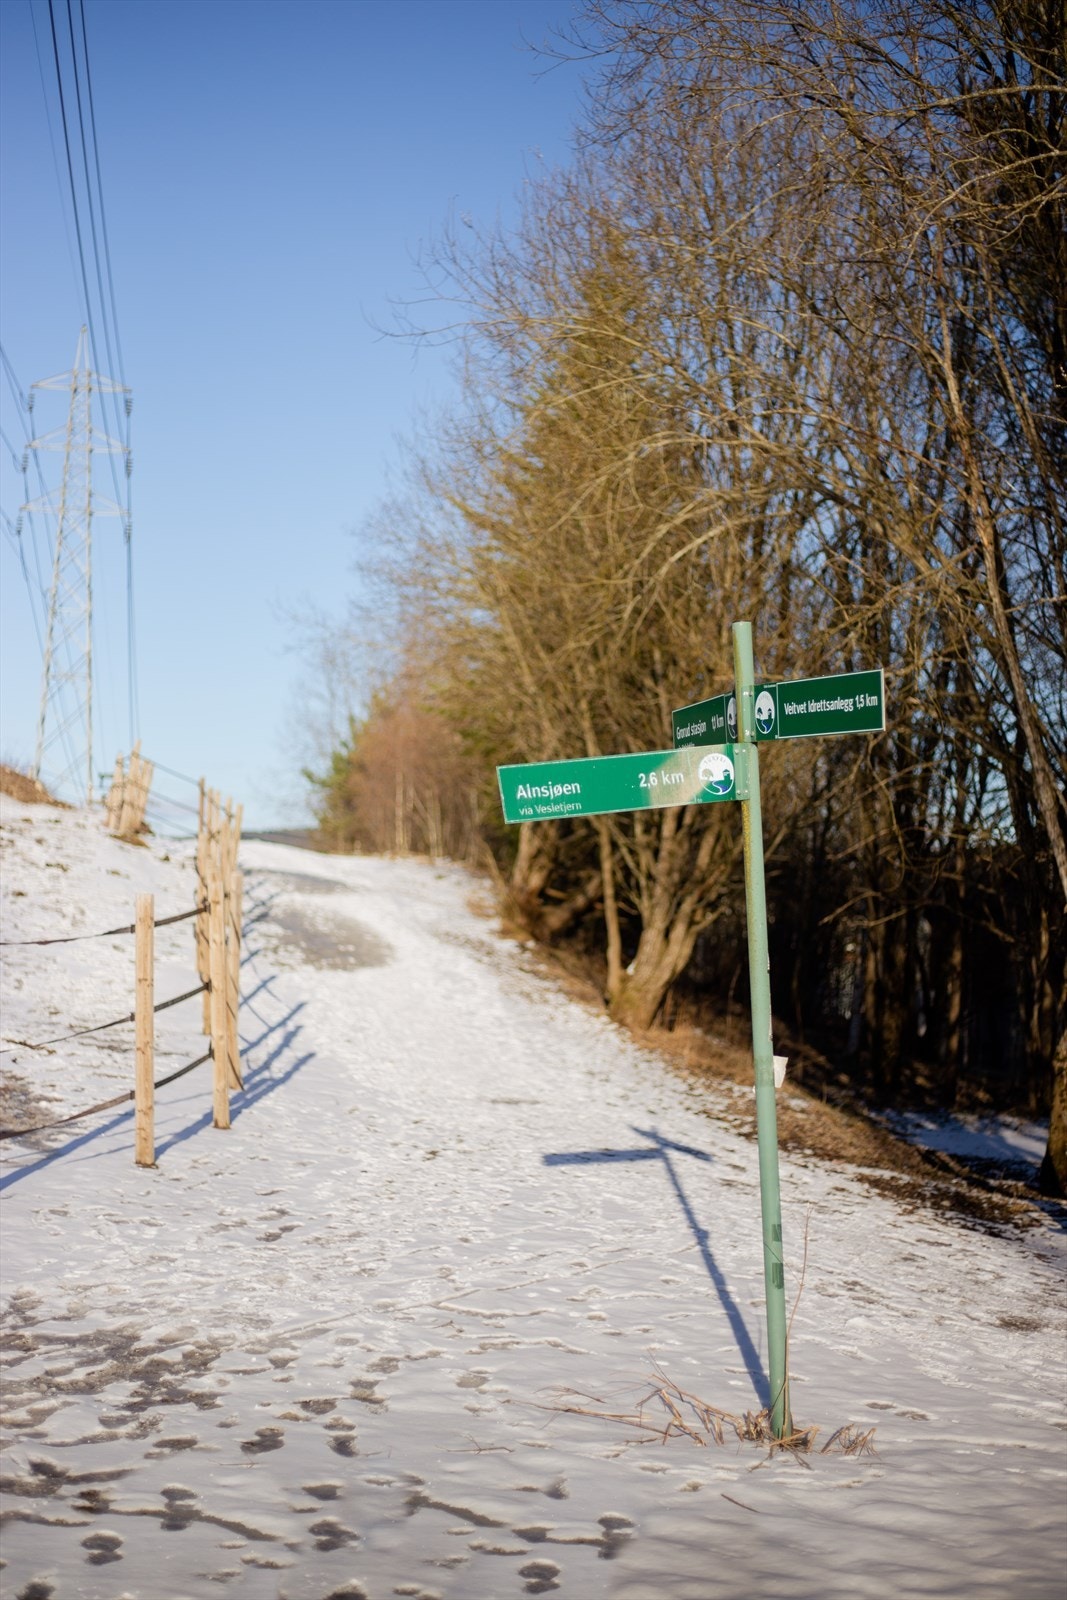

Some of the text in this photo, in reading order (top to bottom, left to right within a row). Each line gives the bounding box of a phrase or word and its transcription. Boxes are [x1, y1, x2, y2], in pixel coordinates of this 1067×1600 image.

[784, 693, 878, 715] Veitvet Idrettsanlegg 1,5 km
[676, 722, 691, 740] Grorud
[691, 719, 707, 737] stasjon
[716, 714, 725, 728] km
[516, 770, 685, 800] Alnsjøen 2,6 km
[519, 802, 582, 815] via Vesletjern
